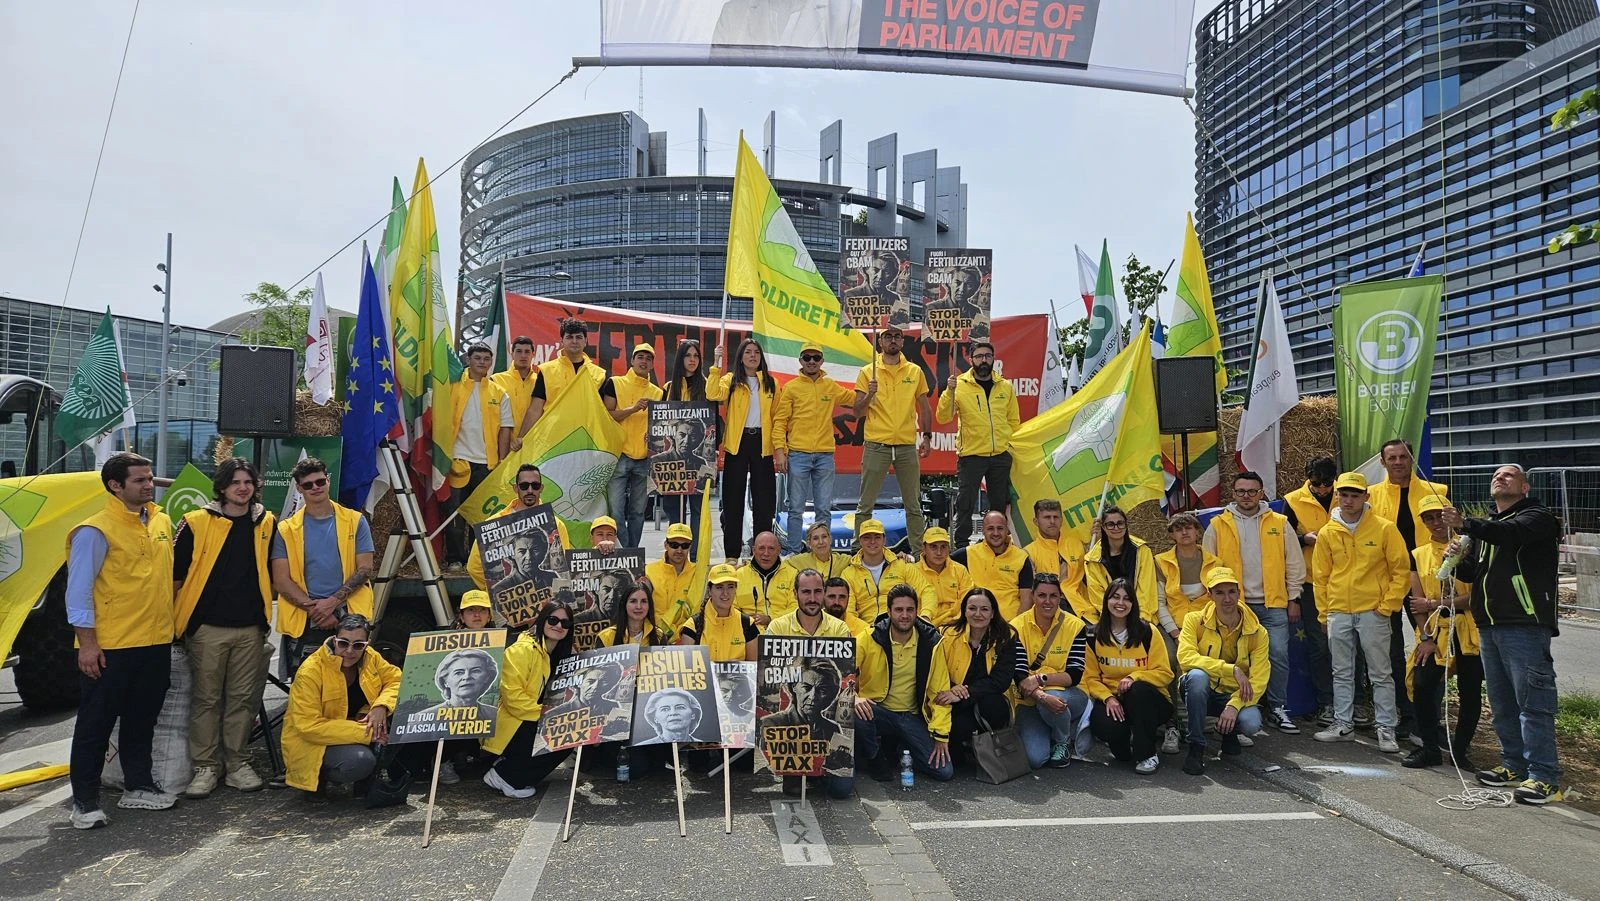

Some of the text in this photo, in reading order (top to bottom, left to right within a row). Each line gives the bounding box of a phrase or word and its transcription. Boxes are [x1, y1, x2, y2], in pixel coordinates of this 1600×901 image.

[883, 0, 1085, 30] THE VOICE OF
[879, 21, 1076, 60] PARLIAMENT
[845, 238, 908, 251] FERTILIZERS
[846, 257, 873, 269] CBAM
[928, 256, 986, 267] FERTILIZZANTI
[927, 273, 952, 284] CBAM
[848, 296, 878, 307] STOP
[850, 305, 891, 316] VON DER
[929, 310, 959, 319] STOP
[853, 316, 881, 326] TAX
[932, 319, 972, 329] VON DER
[934, 329, 961, 340] TAX
[1357, 380, 1416, 398] BOEREN
[1370, 397, 1408, 413] BOND
[652, 408, 710, 420] FERTILIZZANTI
[651, 425, 676, 437] CBAM
[655, 461, 685, 472] STOP
[657, 470, 698, 481] VON DER
[660, 481, 687, 492] TAX
[480, 511, 549, 545] FERTILIZZANTI
[481, 522, 497, 532] FUORI
[485, 543, 515, 563] CBAM
[572, 552, 589, 560] FUORI
[570, 556, 639, 572] FERTILIZZANTI
[498, 581, 534, 603] STOP
[571, 578, 600, 593] CBAM
[503, 587, 552, 612] VON DER
[508, 604, 541, 624] TAX
[574, 621, 610, 635] STOP
[424, 632, 490, 652] URSULA
[763, 638, 853, 659] FERTILIZERS
[555, 650, 630, 675] FERTILIZZANTI
[639, 649, 707, 676] RSULA
[770, 656, 794, 667] OUT OF
[764, 666, 802, 684] CBAM
[551, 675, 584, 691] CBAM
[637, 672, 707, 694] ERTI-LIES
[407, 706, 478, 723] IL TUO PATTO
[548, 709, 589, 727] STOP
[396, 720, 492, 735] CI LASCIA AL VERDE
[550, 716, 606, 737] VON DER
[722, 724, 748, 733] DER
[766, 727, 809, 740] STOP
[551, 730, 588, 747] TAX
[769, 741, 827, 755] VON DER
[772, 756, 812, 771] TAX
